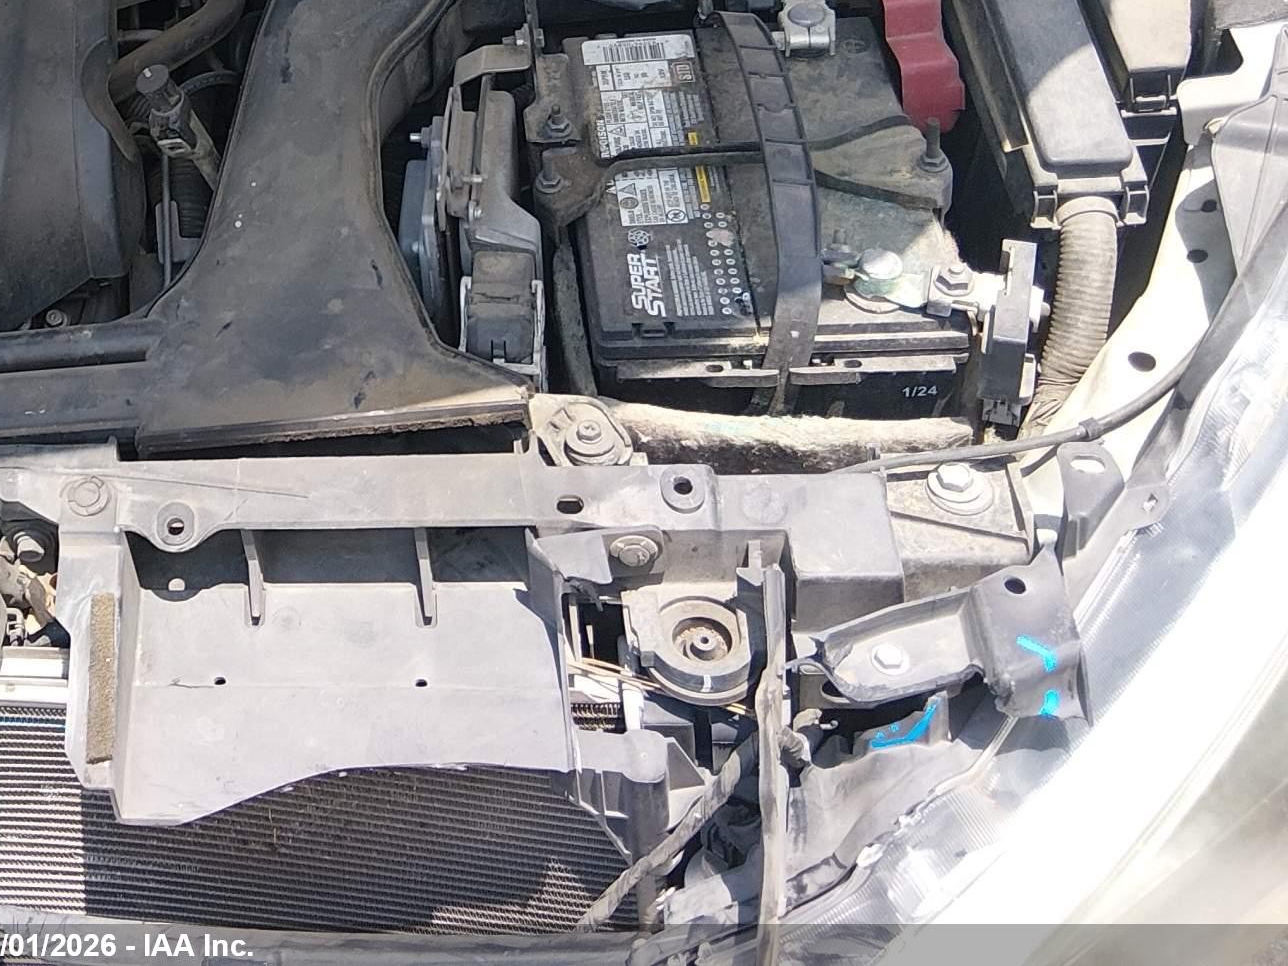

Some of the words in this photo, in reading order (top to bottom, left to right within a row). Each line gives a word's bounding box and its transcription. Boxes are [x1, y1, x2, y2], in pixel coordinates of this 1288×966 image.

[626, 253, 649, 311] SUPER
[640, 250, 667, 317] START
[902, 385, 938, 398] 1/24
